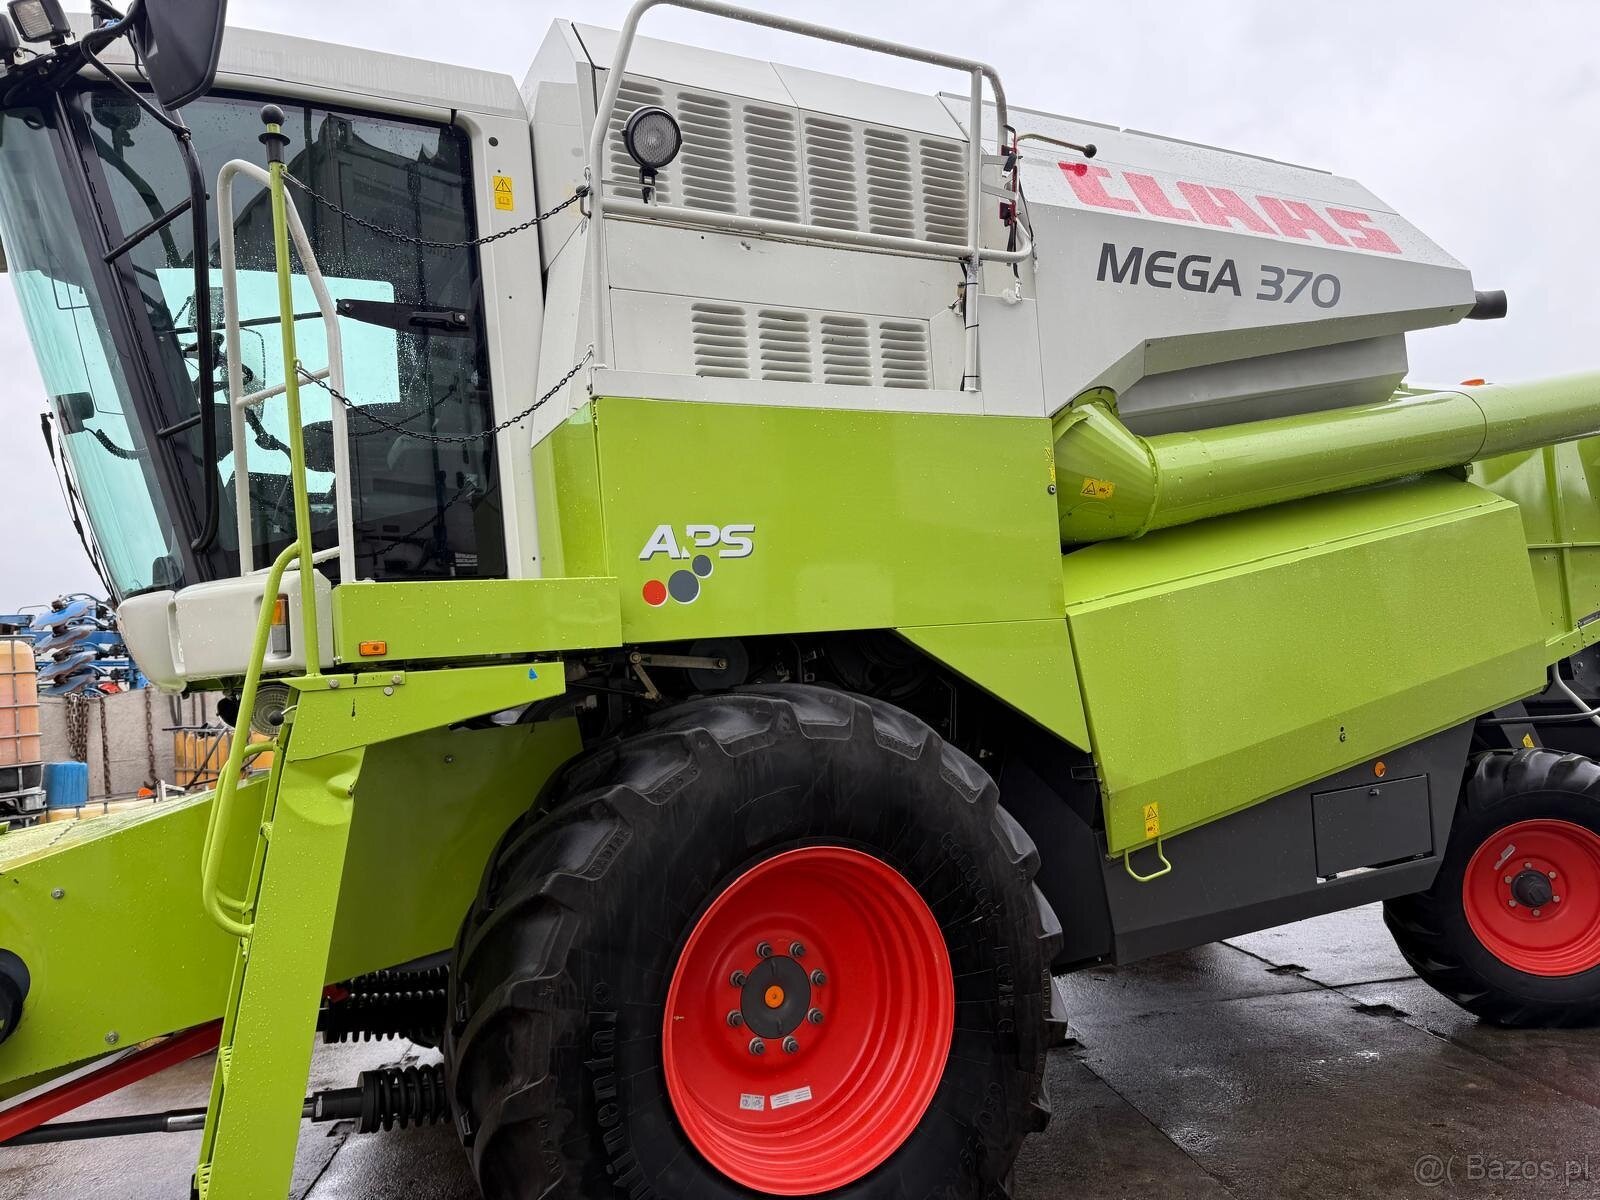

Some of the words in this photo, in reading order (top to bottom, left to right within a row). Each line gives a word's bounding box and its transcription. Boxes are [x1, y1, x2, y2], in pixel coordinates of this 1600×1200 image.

[1057, 161, 1402, 254] CLAAS
[1096, 241, 1242, 296] MEGA
[1256, 264, 1341, 308] 370
[638, 523, 756, 561] APS
